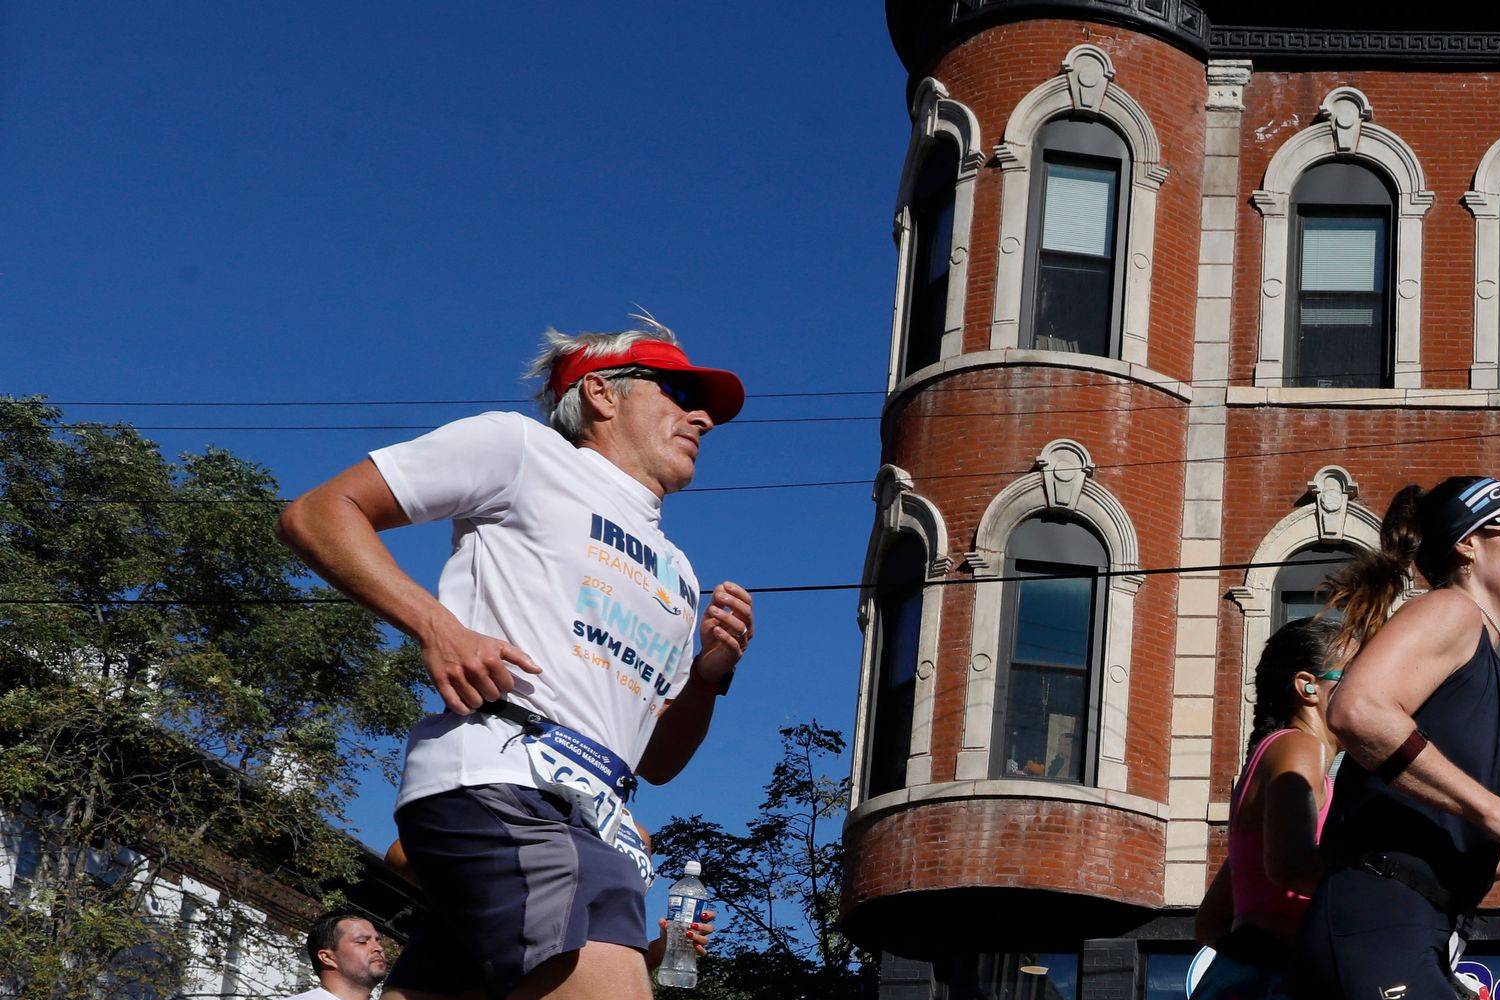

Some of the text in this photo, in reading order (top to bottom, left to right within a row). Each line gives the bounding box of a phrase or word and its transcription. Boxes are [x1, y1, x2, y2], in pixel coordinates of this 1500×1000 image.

[582, 575, 614, 596] 2022
[587, 545, 650, 592] FRANCE
[576, 586, 683, 674] FINISHE
[554, 736, 612, 776] CHICAGO MARATHON
